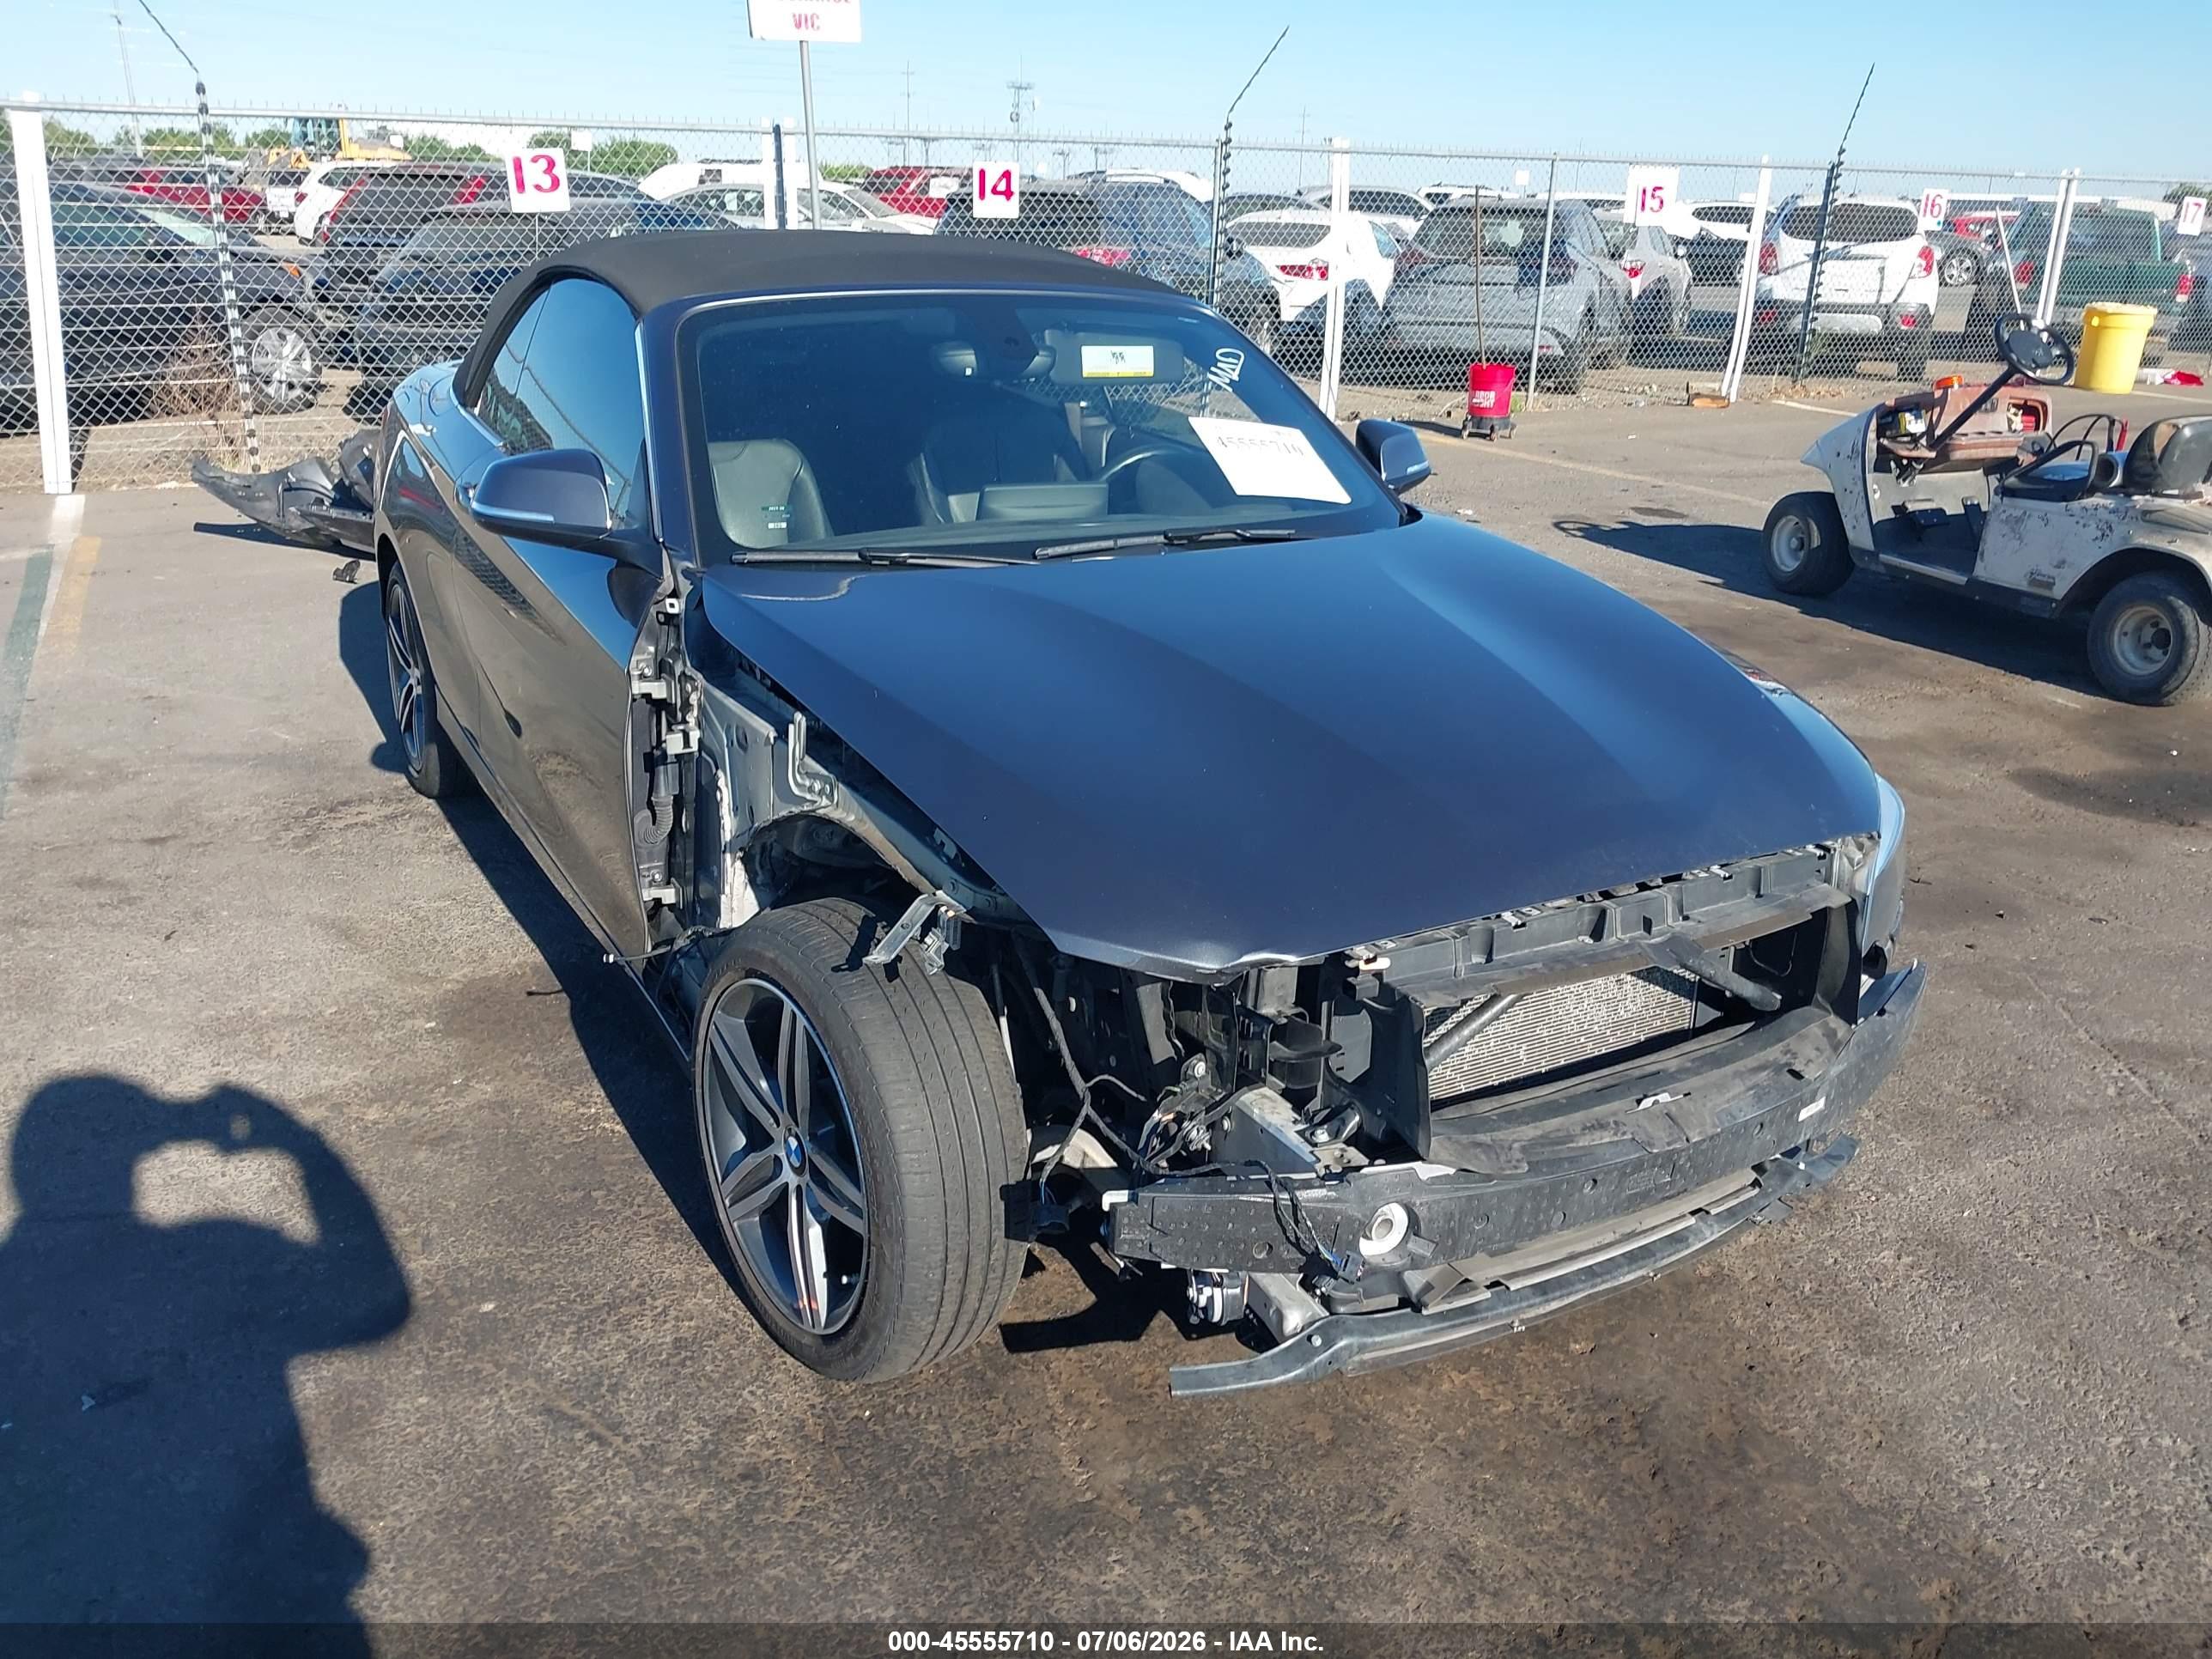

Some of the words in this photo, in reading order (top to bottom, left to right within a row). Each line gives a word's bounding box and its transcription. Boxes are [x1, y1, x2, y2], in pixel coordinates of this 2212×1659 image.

[792, 13, 821, 31] VIC
[513, 155, 561, 195] 13
[979, 168, 1015, 202] 14
[1640, 185, 1664, 213] 15
[1922, 192, 1943, 219] 16
[2182, 201, 2203, 224] 17
